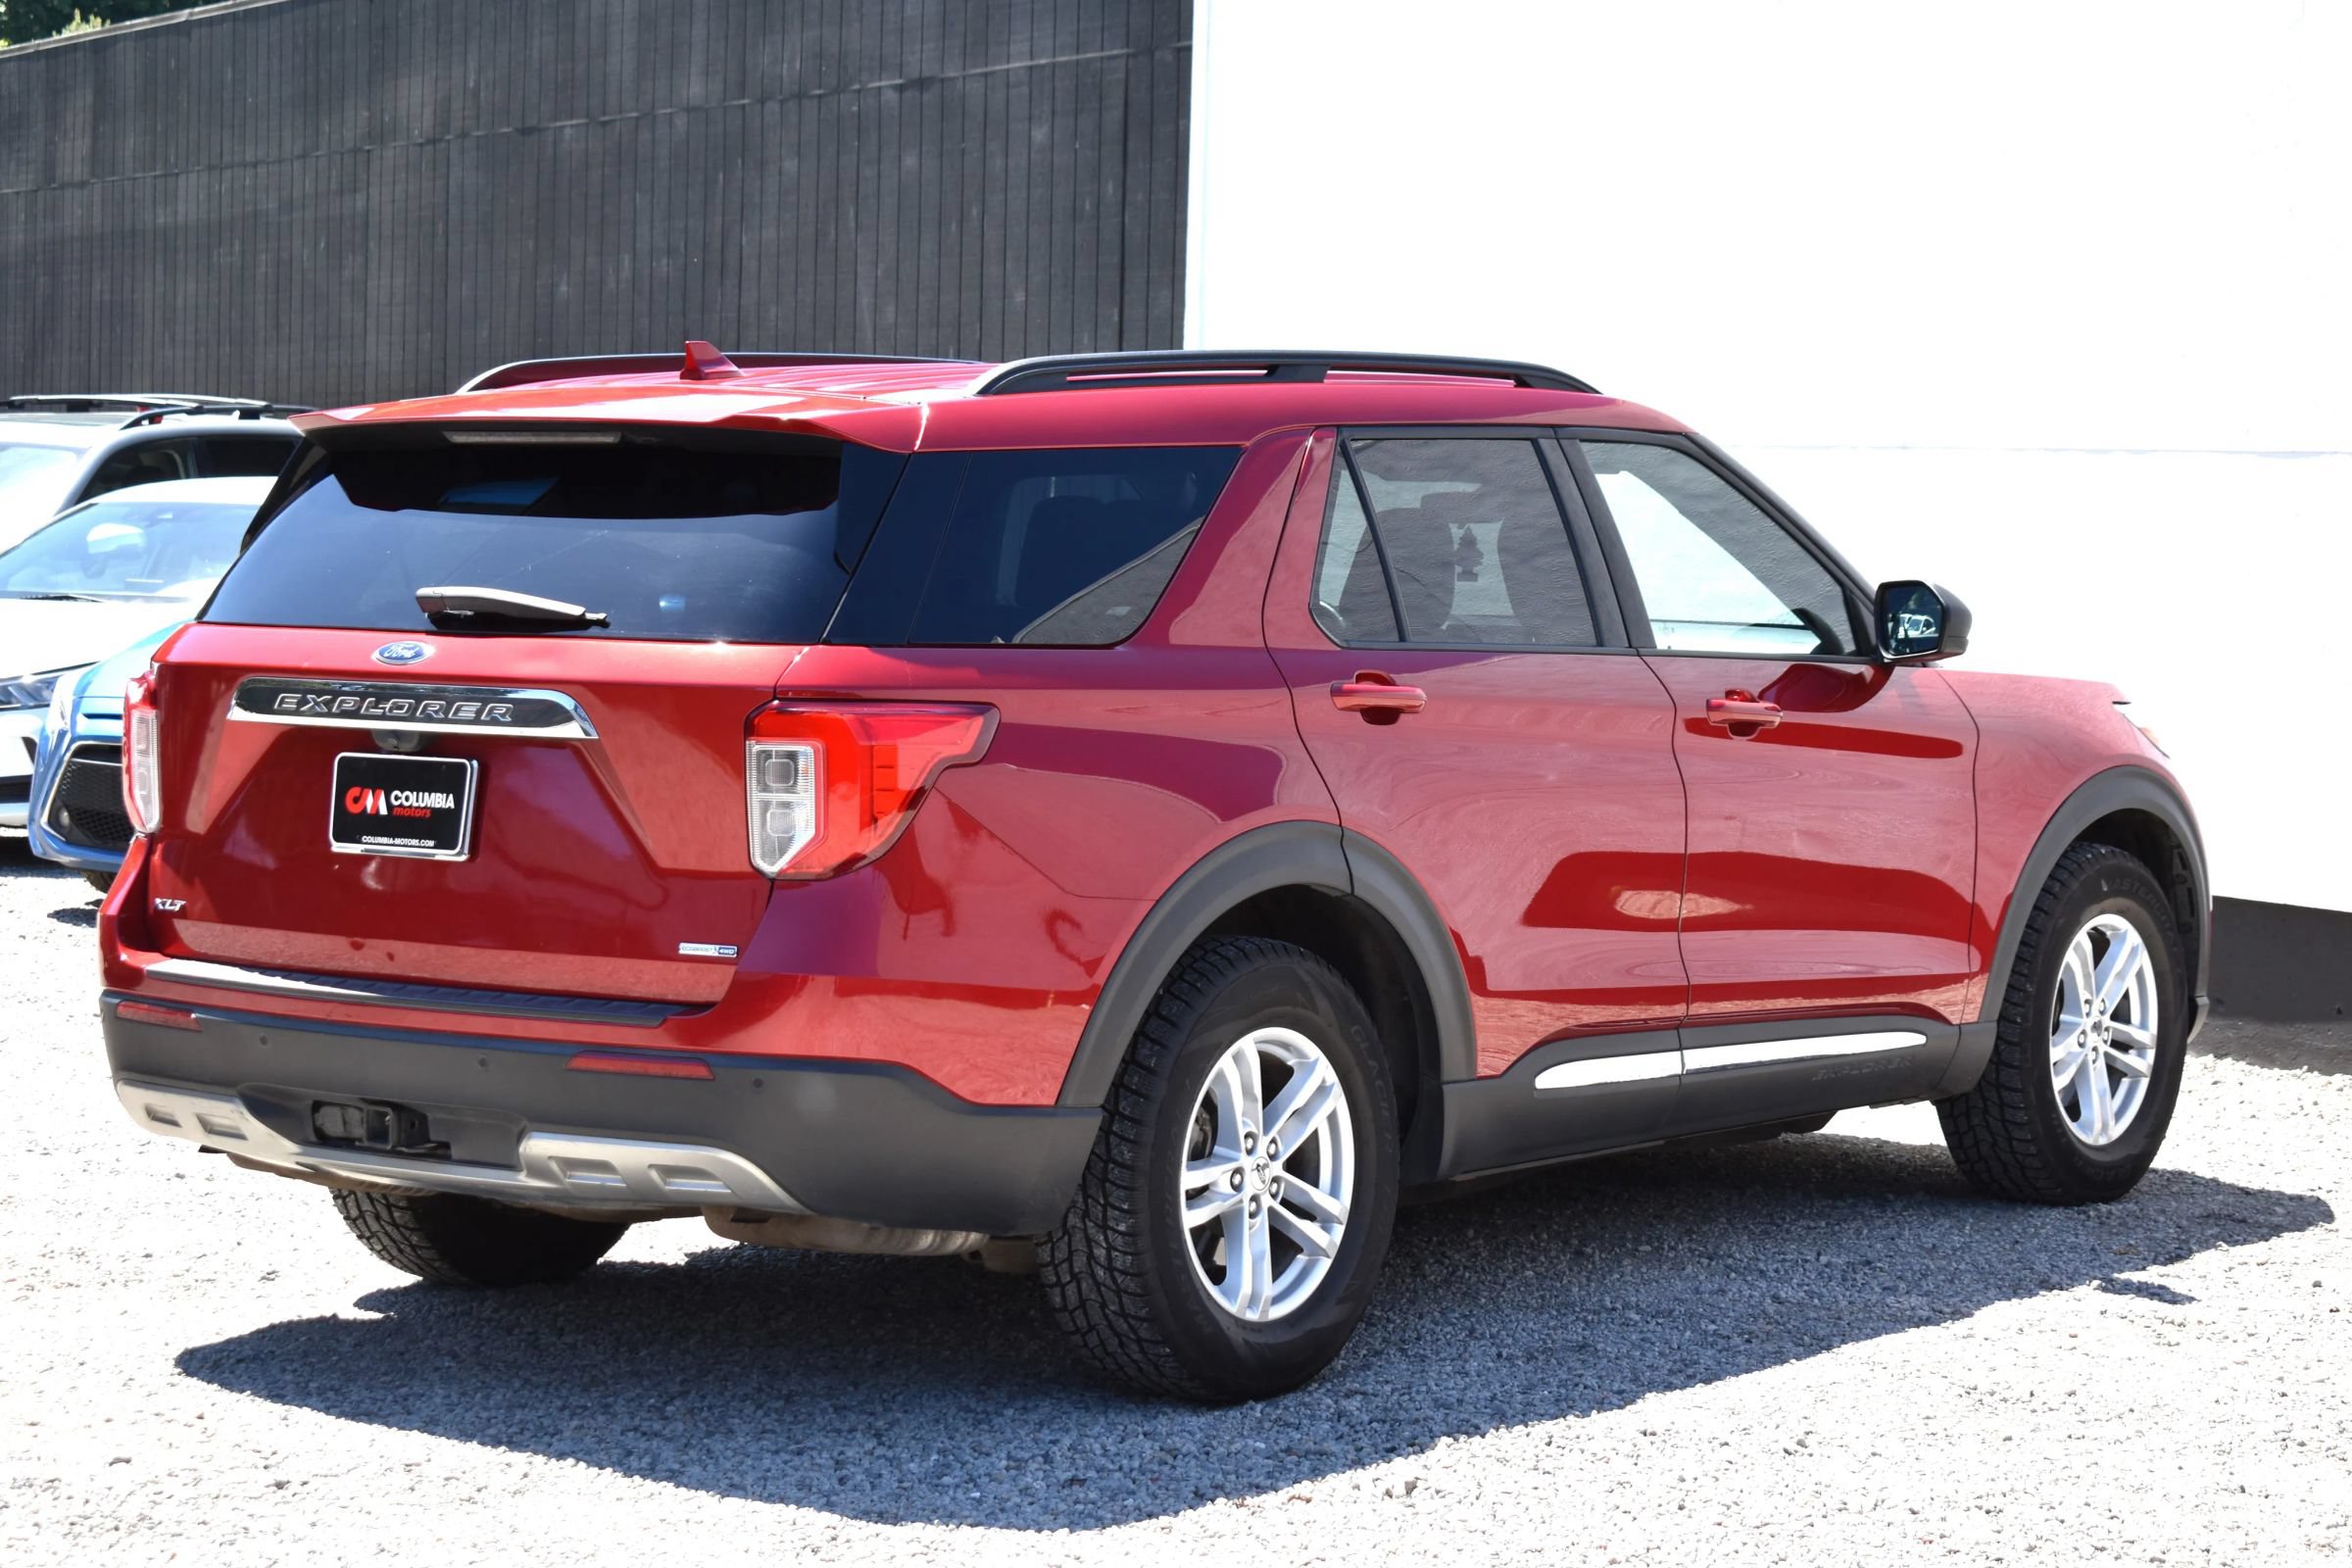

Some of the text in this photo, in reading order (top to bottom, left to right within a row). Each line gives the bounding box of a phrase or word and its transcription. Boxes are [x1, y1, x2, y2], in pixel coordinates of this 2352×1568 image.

[383, 643, 421, 659] Ford
[273, 693, 514, 721] EXPLORER
[391, 790, 455, 808] COLUMBIA
[393, 807, 431, 817] motors
[361, 835, 435, 847] COLUMBIA-MOTORS.COM
[155, 897, 187, 911] XLT
